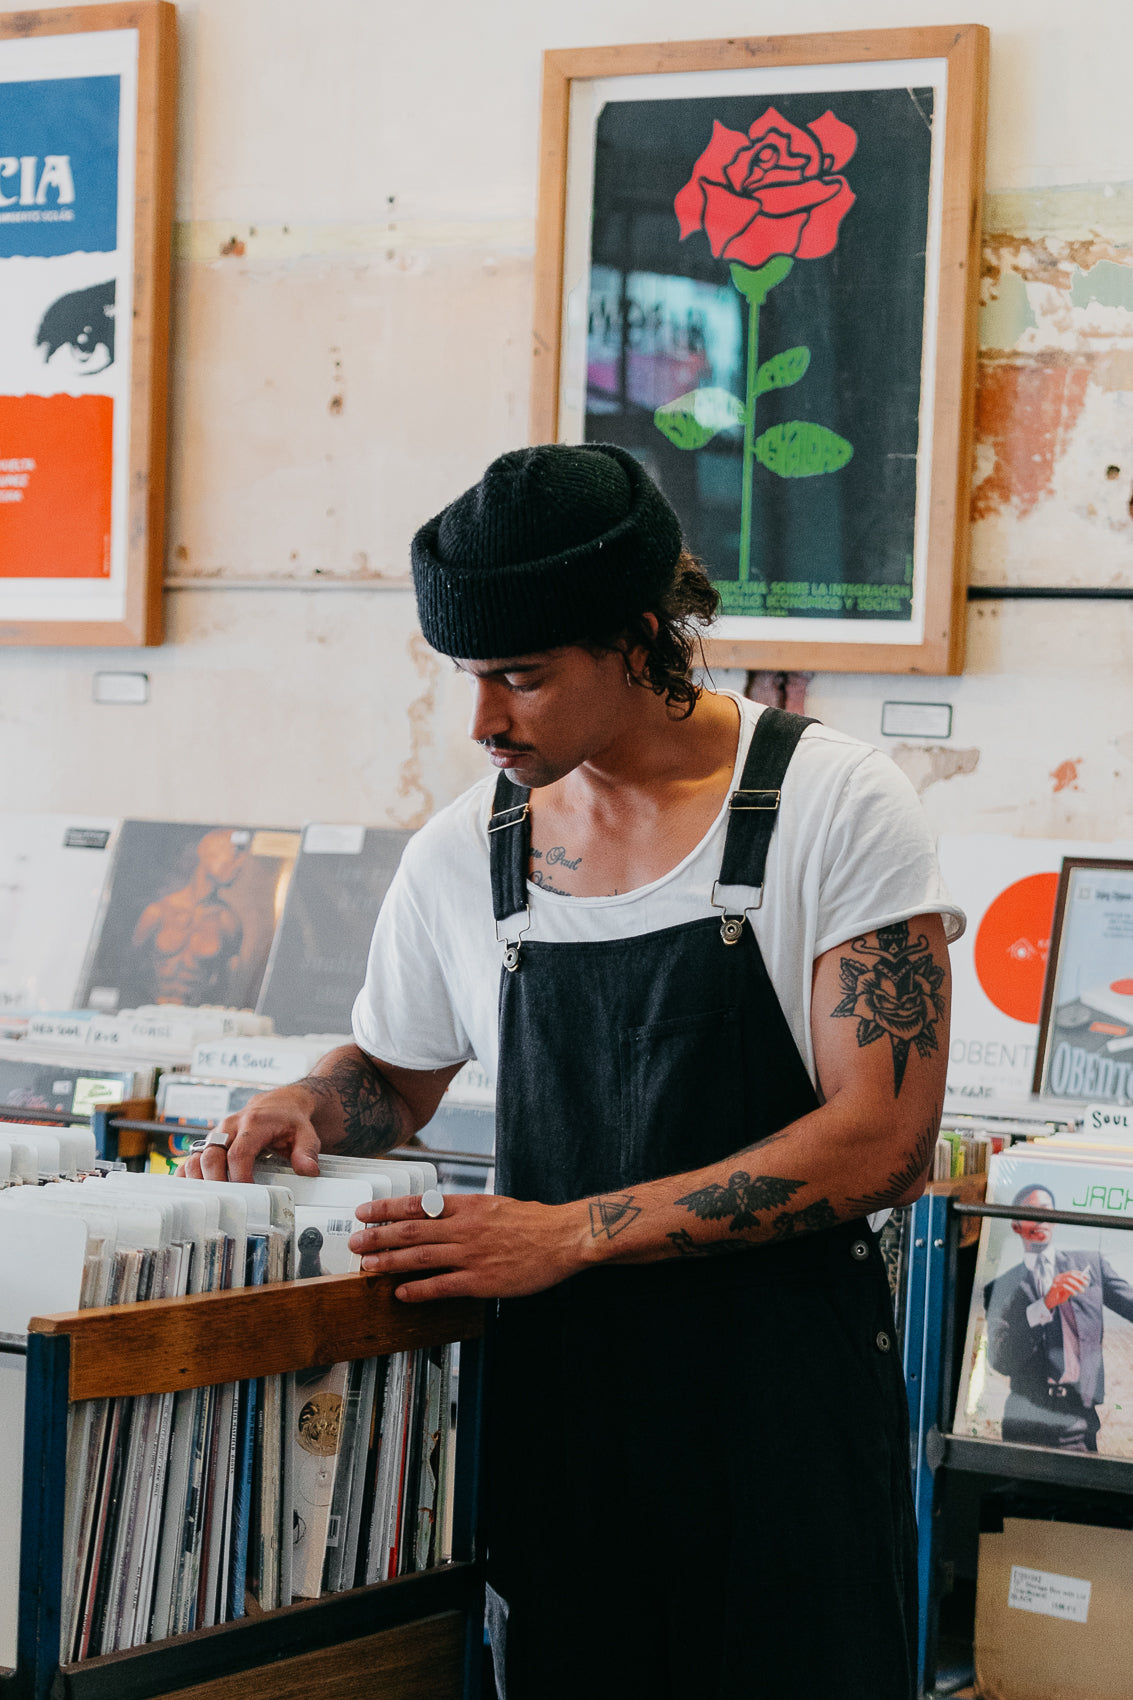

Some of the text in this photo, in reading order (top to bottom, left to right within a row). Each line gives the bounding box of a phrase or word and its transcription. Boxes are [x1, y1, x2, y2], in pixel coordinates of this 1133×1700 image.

[811, 582, 828, 596] LA
[844, 597, 856, 610] Y
[857, 597, 902, 611] SOCIAL
